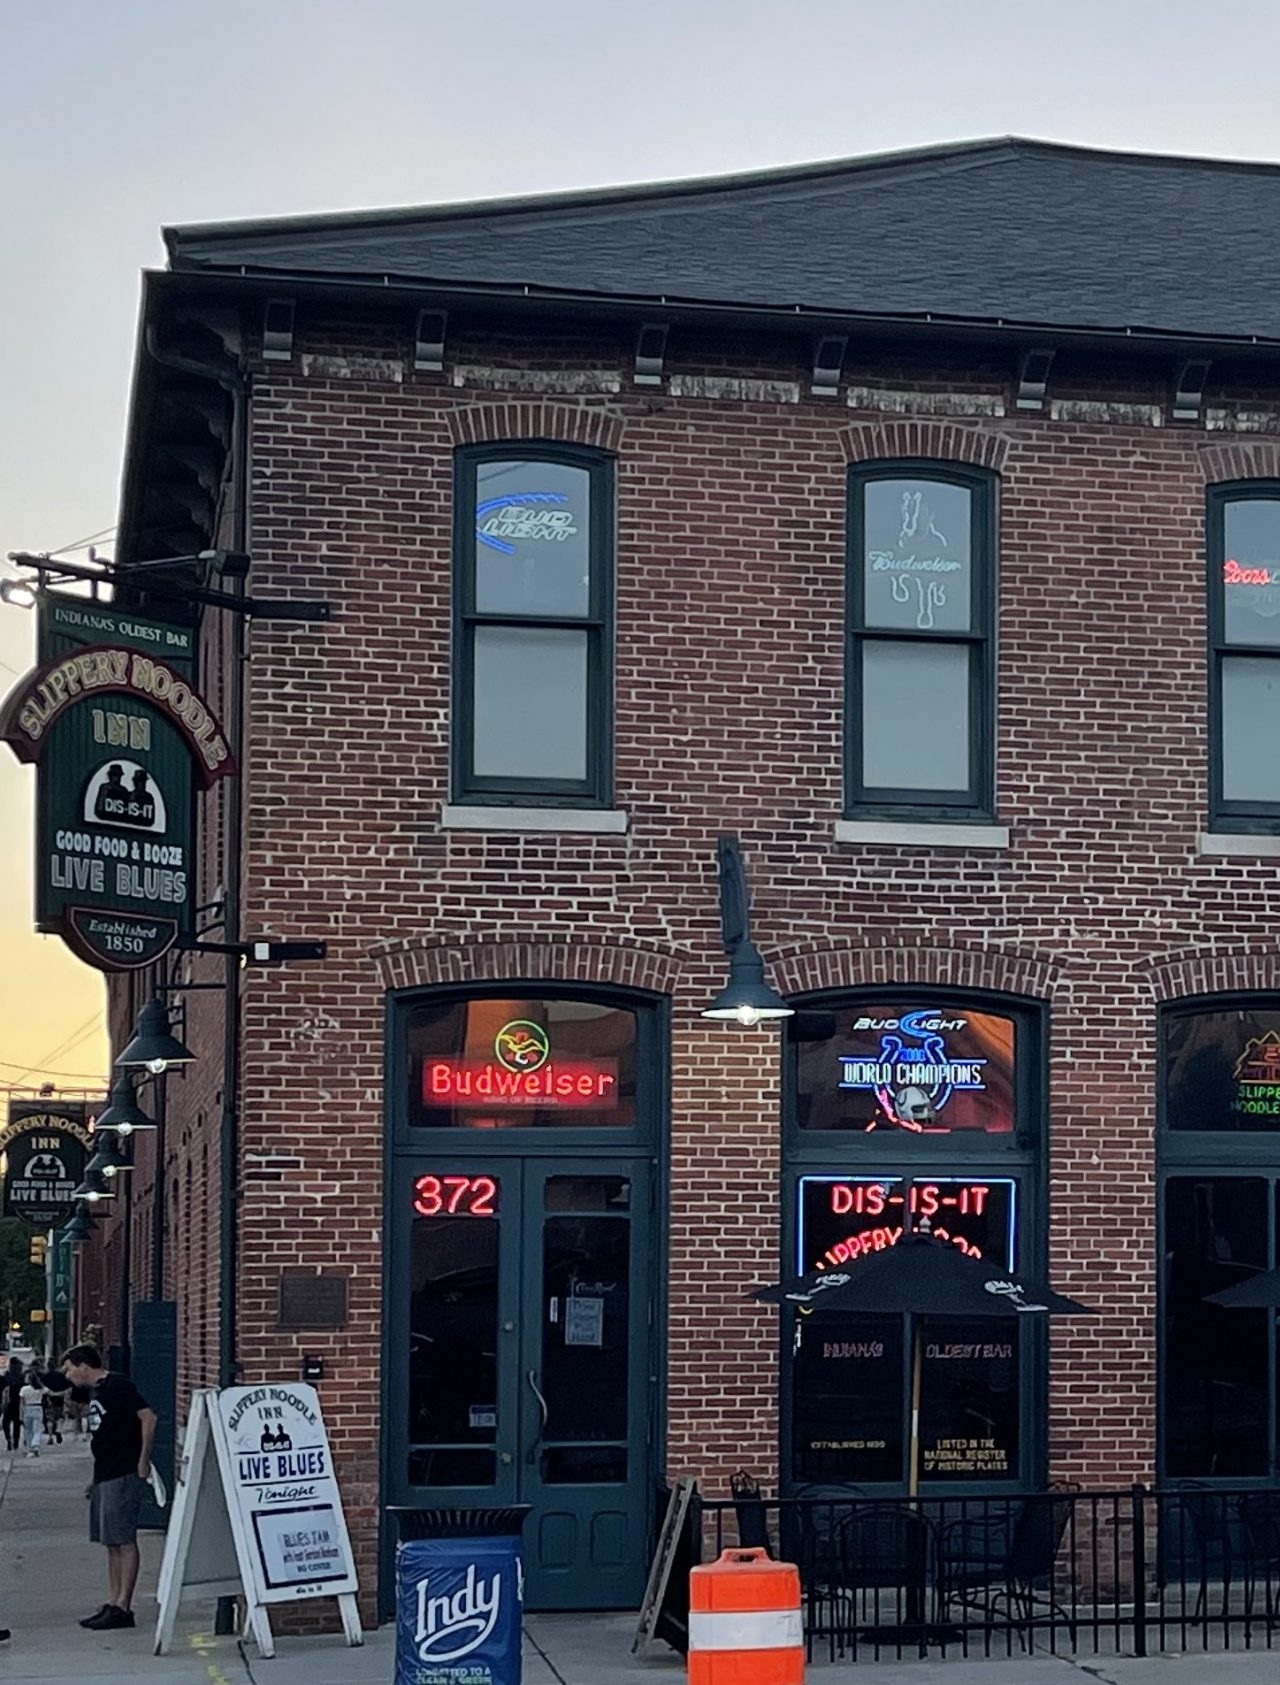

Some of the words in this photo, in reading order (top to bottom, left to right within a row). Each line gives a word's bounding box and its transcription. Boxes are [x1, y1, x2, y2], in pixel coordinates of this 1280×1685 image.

[869, 551, 961, 571] Budweiser
[55, 607, 115, 632] INDIANA'S
[119, 621, 161, 646] OLDEST
[166, 630, 188, 648] BAR
[18, 650, 129, 741] SLIPPERY
[131, 654, 228, 771] NOODLE
[92, 709, 151, 752] INN
[104, 796, 154, 822] DIS-IS-IT
[56, 829, 92, 853] GOOD
[94, 836, 128, 859] FOOD
[131, 841, 141, 860] &
[143, 842, 182, 866] BOOZE
[51, 854, 104, 893] LIVE
[116, 864, 187, 903] BLUES
[88, 917, 157, 940] Established
[104, 934, 144, 955] 1850
[912, 1018, 968, 1031] LIGHT
[431, 1064, 615, 1096] Budweiser
[843, 1063, 893, 1084] WORLD
[896, 1063, 982, 1084] CHAMPIONS
[31, 1137, 60, 1149] INN
[10, 1188, 37, 1201] LIVE
[414, 1175, 496, 1216] 372
[832, 1184, 989, 1216] DIS-IS-IT
[926, 1344, 980, 1358] OLDEST
[229, 1388, 267, 1432] SLIPPERY
[269, 1388, 317, 1426] NOODLE
[257, 1406, 283, 1420] INN
[240, 1456, 271, 1480] LIVE
[277, 1451, 324, 1477] BLUES
[414, 1563, 500, 1663] Indy
[470, 1667, 483, 1676] TO
[484, 1667, 491, 1676] A
